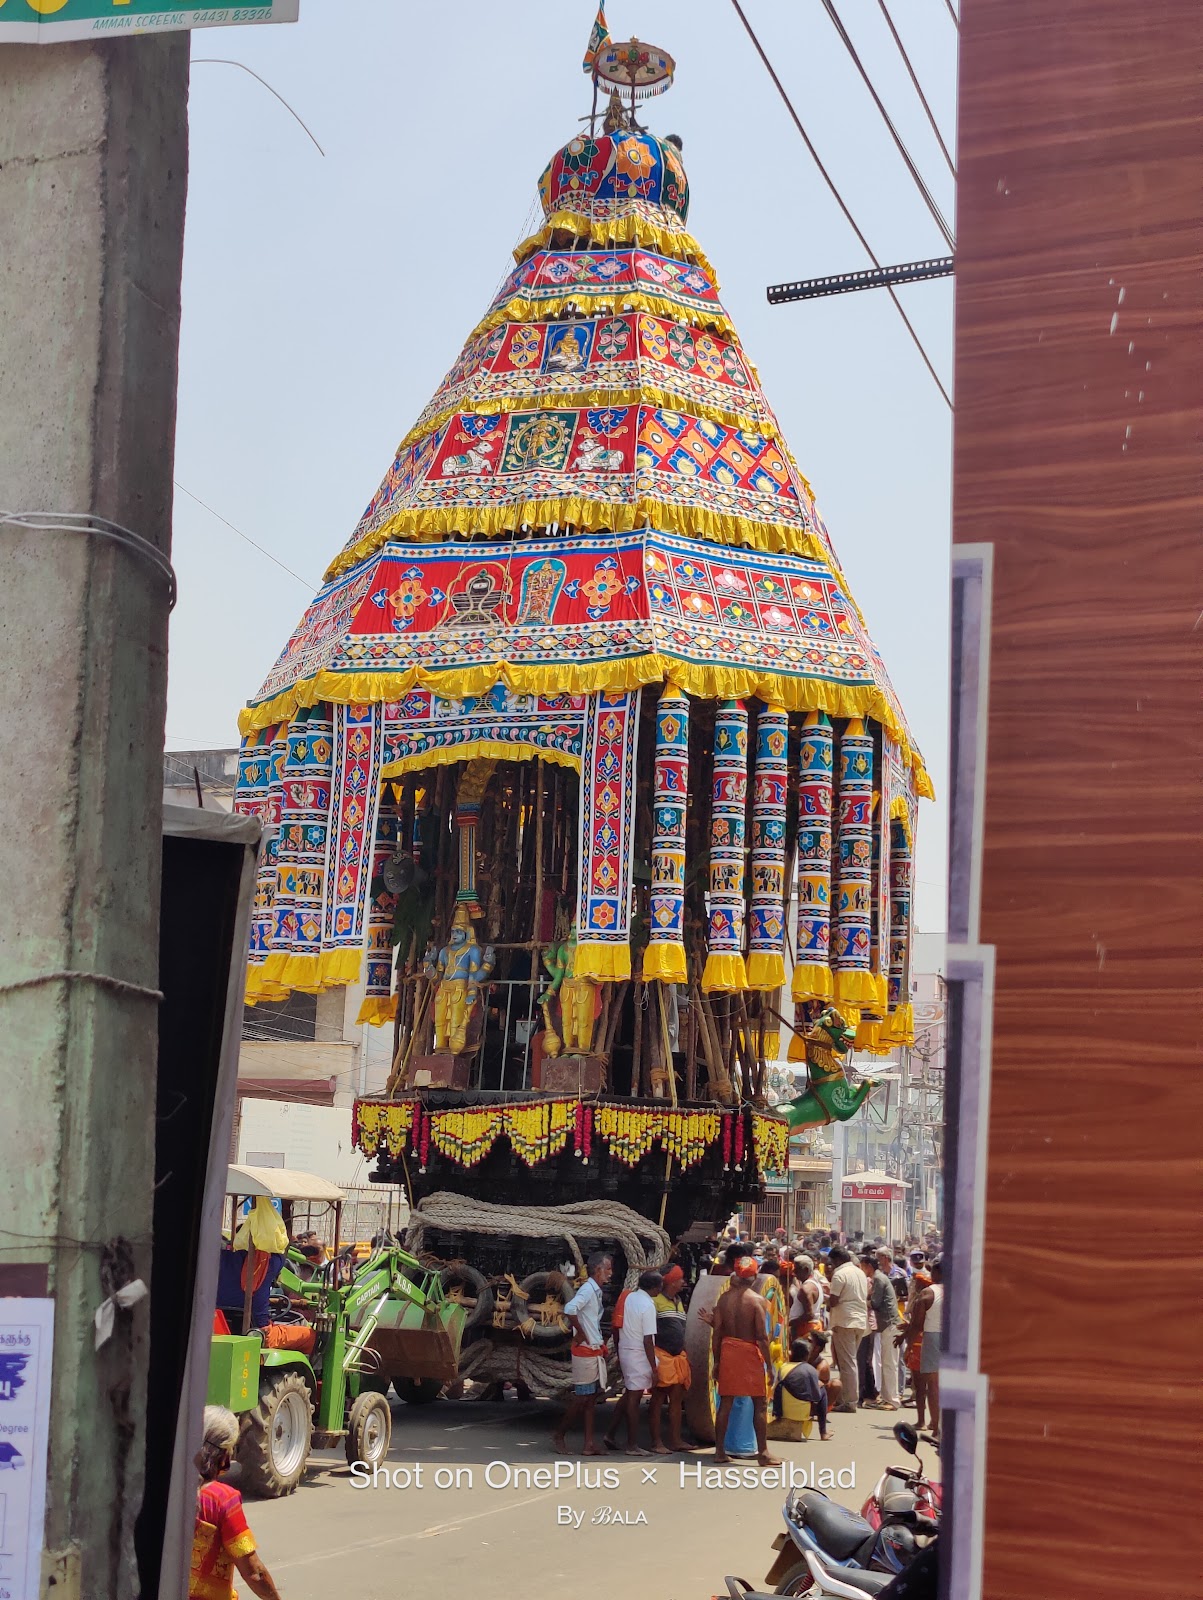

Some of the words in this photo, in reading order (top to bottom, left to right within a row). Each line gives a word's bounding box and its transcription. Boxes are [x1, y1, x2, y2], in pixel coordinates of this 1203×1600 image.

[92, 17, 133, 31] AMMAN
[193, 10, 229, 23] 94431
[231, 8, 272, 21] 83326
